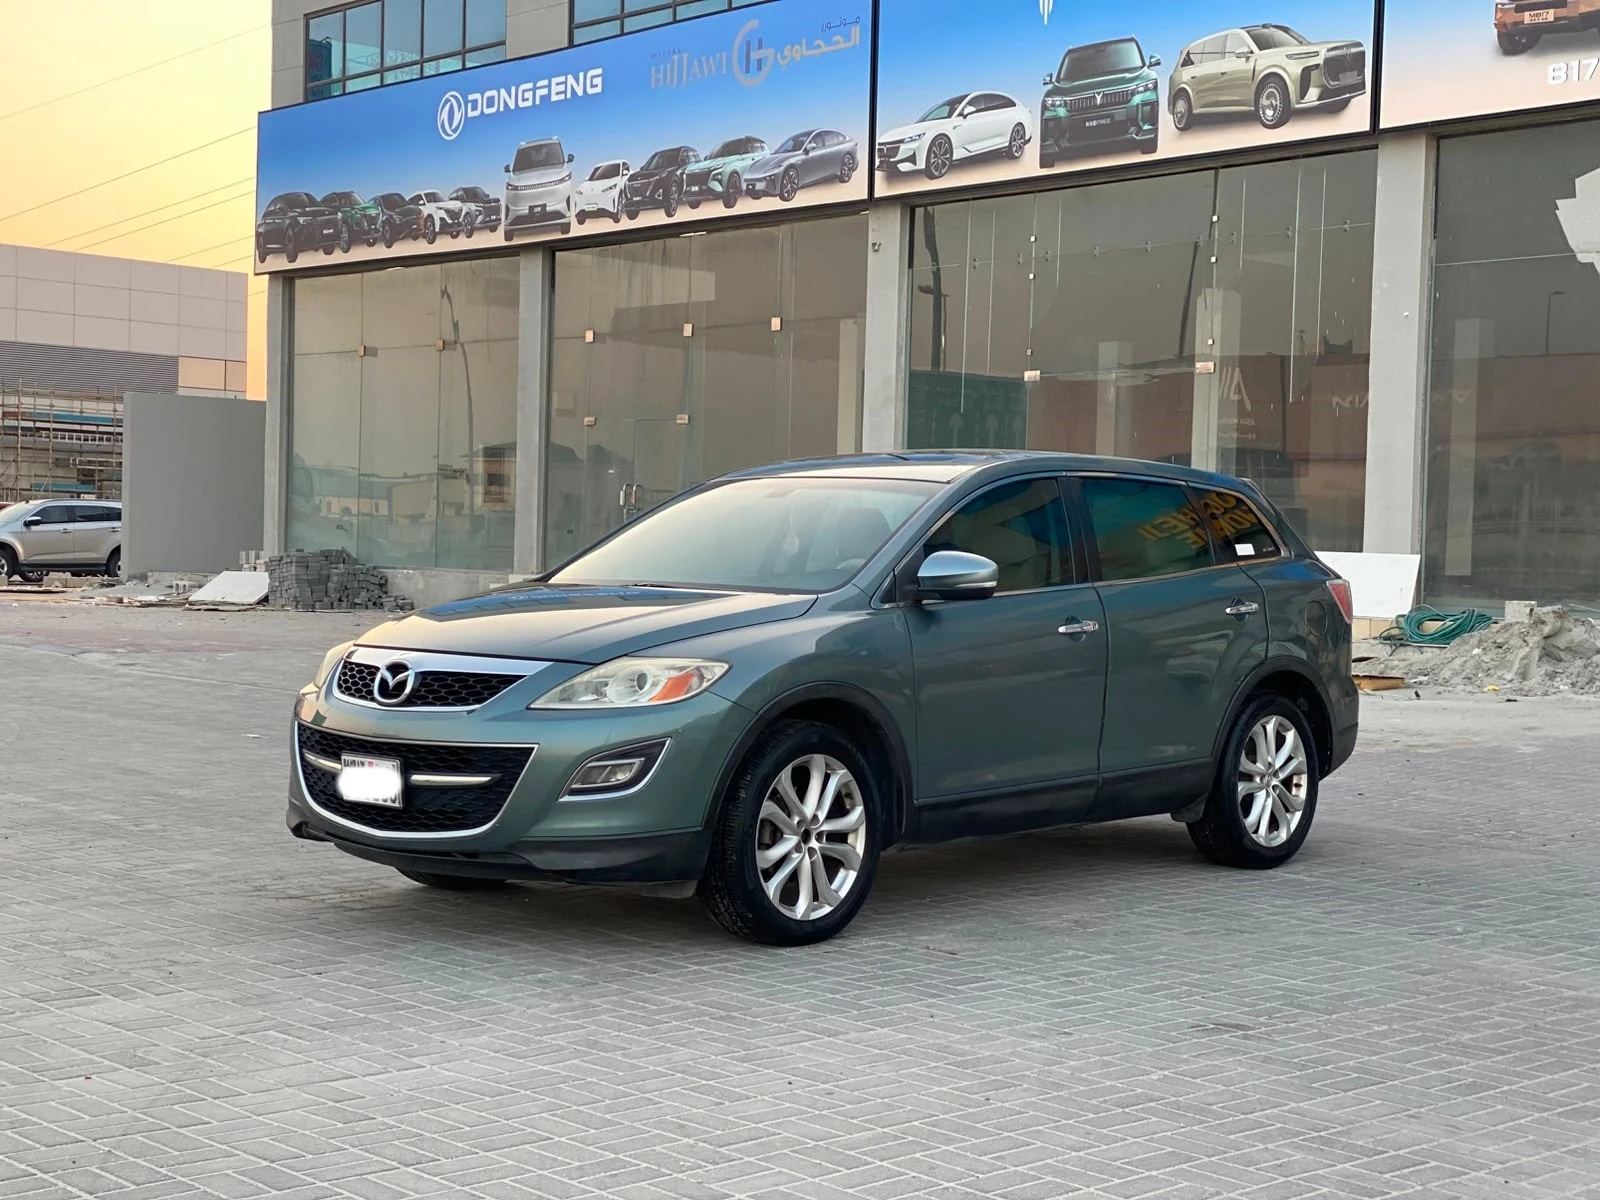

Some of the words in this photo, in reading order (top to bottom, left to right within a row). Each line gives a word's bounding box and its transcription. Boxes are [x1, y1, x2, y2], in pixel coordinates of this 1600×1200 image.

[651, 48, 681, 58] MOTORS
[776, 26, 860, 68] الحجاوي
[651, 53, 727, 88] HIJJAWI
[1548, 58, 1599, 84] 817
[467, 68, 603, 118] DONGFENG
